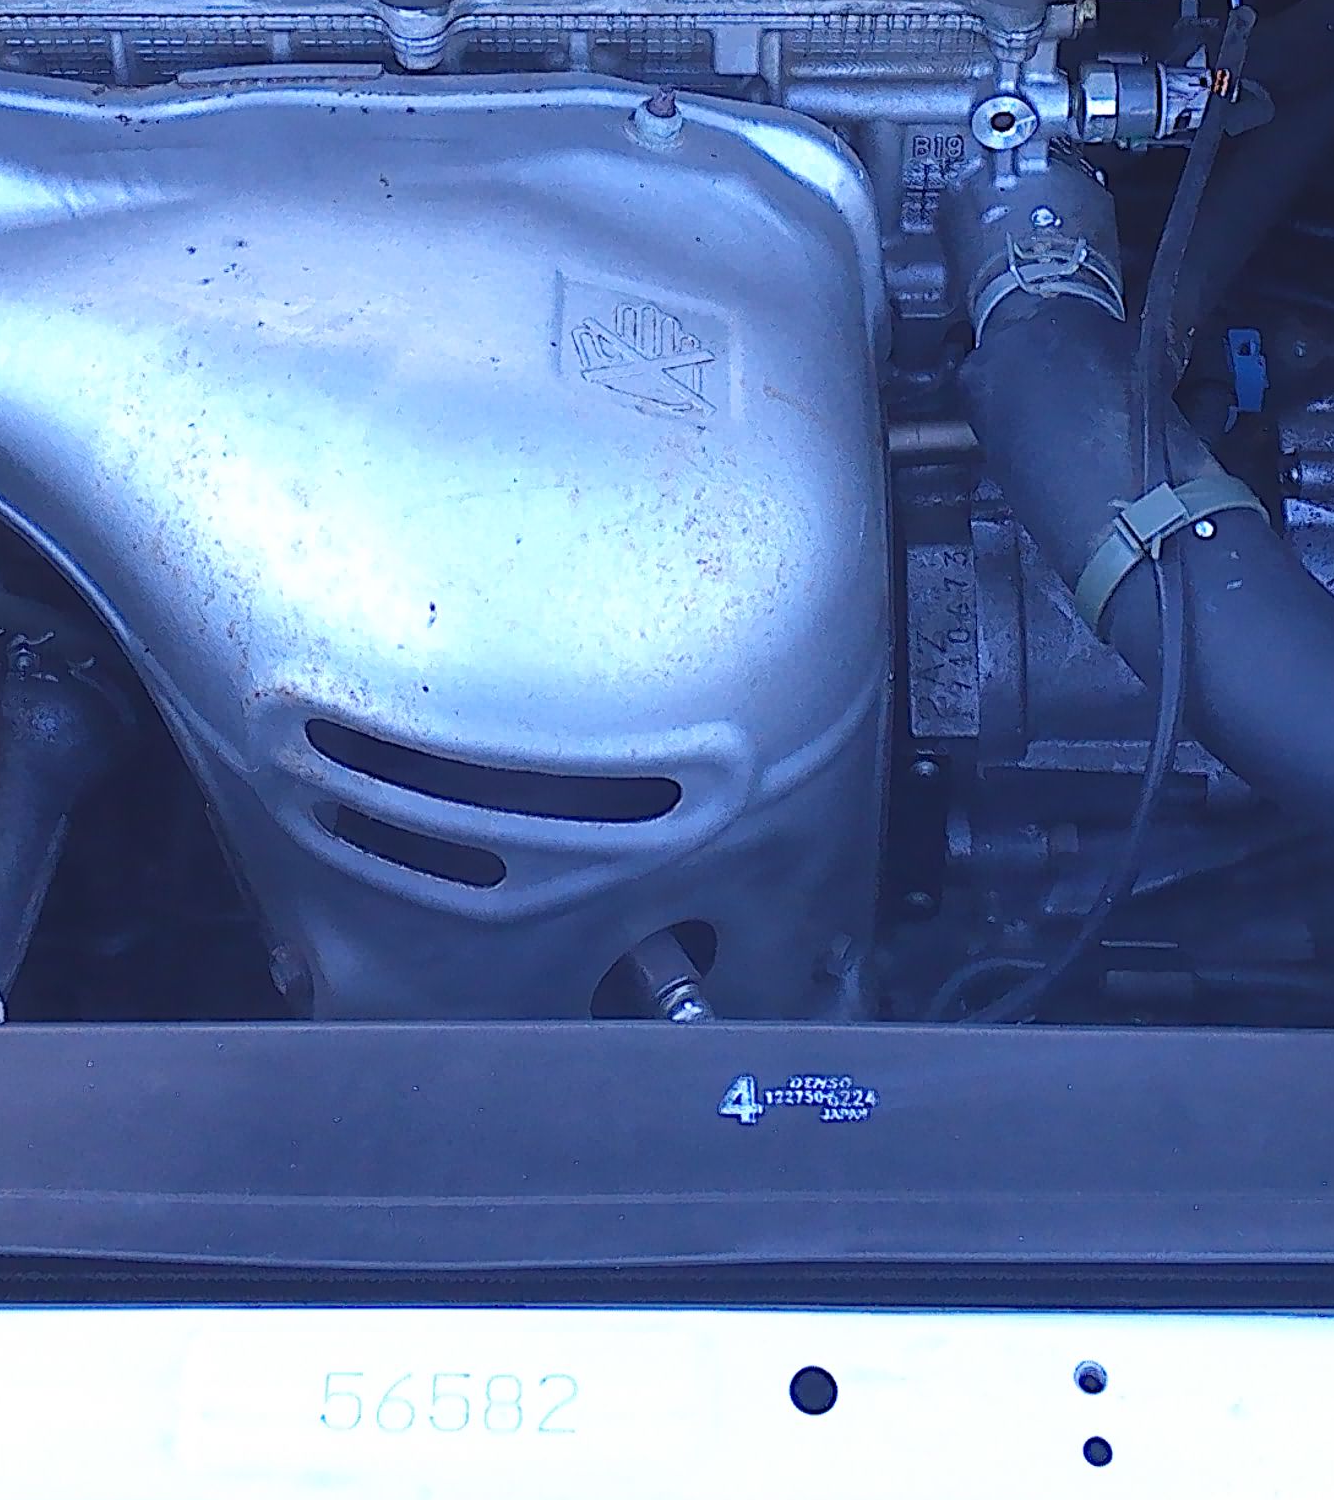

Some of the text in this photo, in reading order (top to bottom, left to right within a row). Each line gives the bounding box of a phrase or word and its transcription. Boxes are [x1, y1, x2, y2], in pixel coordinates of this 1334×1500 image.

[718, 1074, 764, 1124] 4
[789, 1076, 853, 1090] DENSO
[820, 1108, 870, 1122] JAPAN
[319, 1371, 580, 1435] 56582
